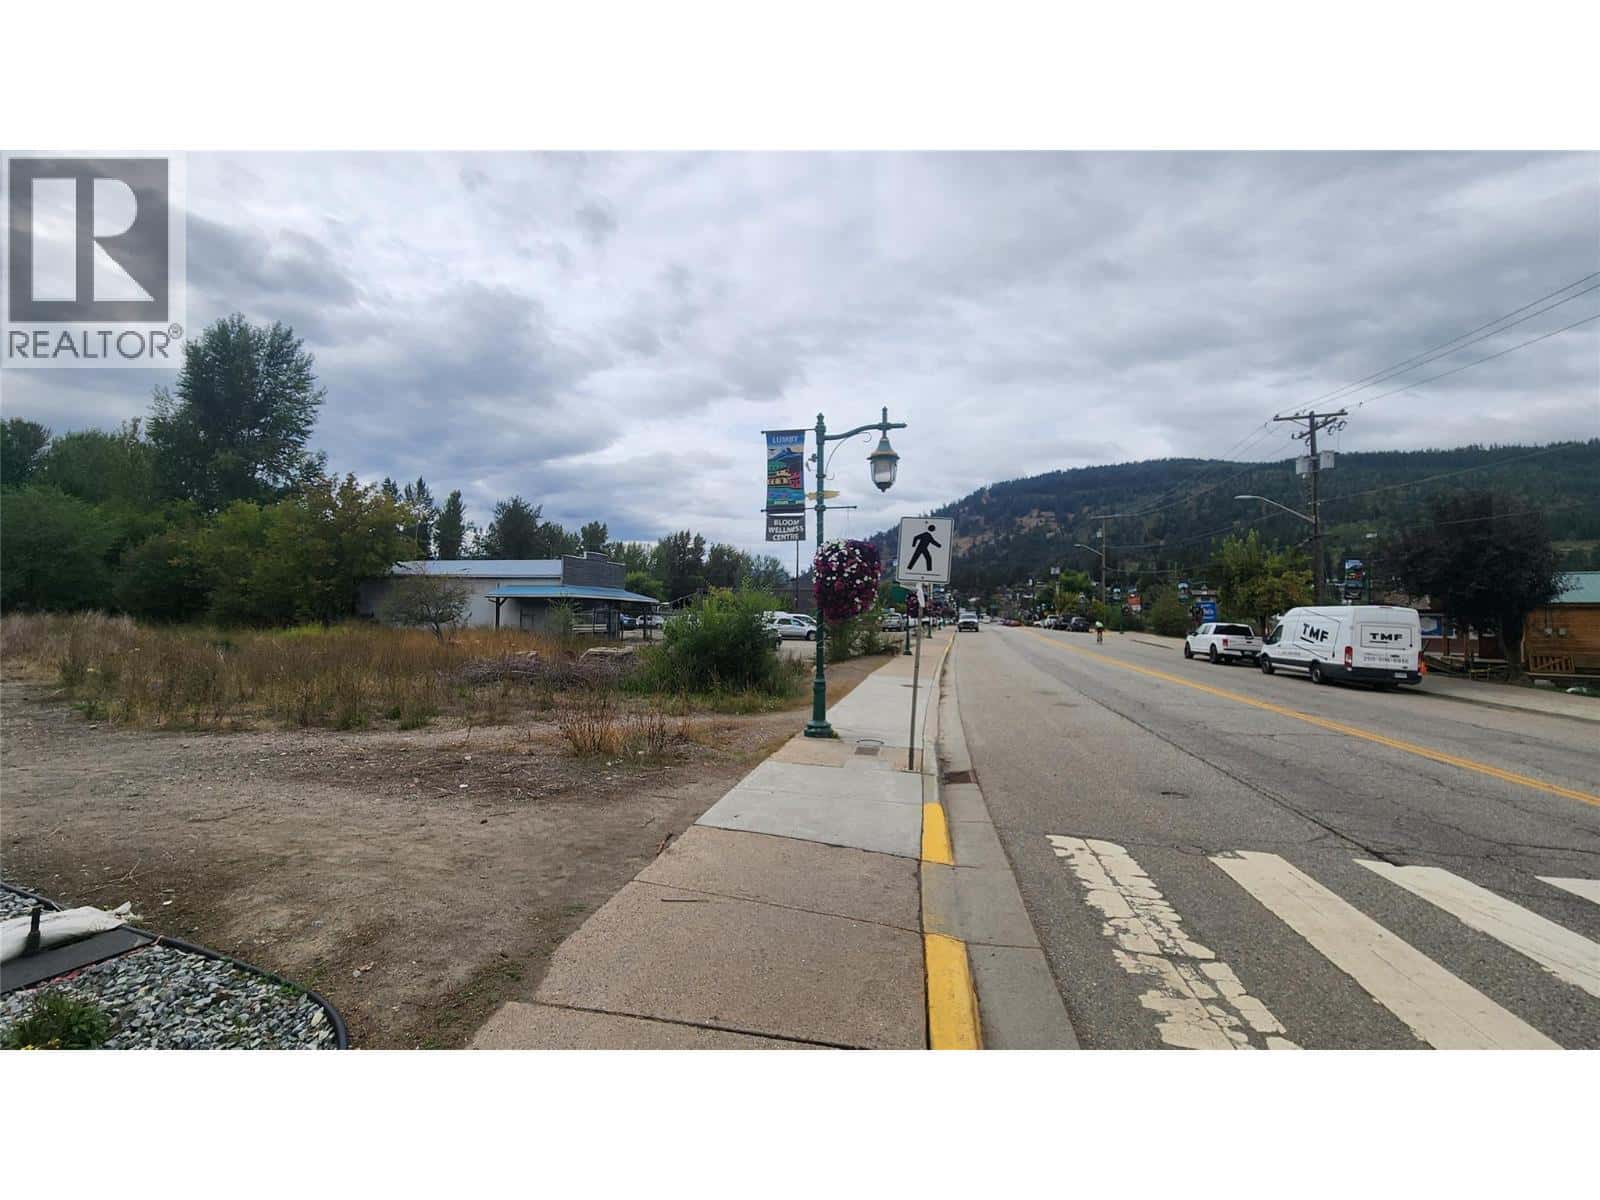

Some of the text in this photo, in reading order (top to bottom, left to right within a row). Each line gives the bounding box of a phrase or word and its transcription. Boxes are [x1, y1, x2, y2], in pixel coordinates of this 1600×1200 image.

[767, 525, 804, 534] WELLNESS
[772, 533, 800, 541] CENTRE
[1303, 623, 1329, 642] TMF
[1369, 632, 1403, 641] TMF
